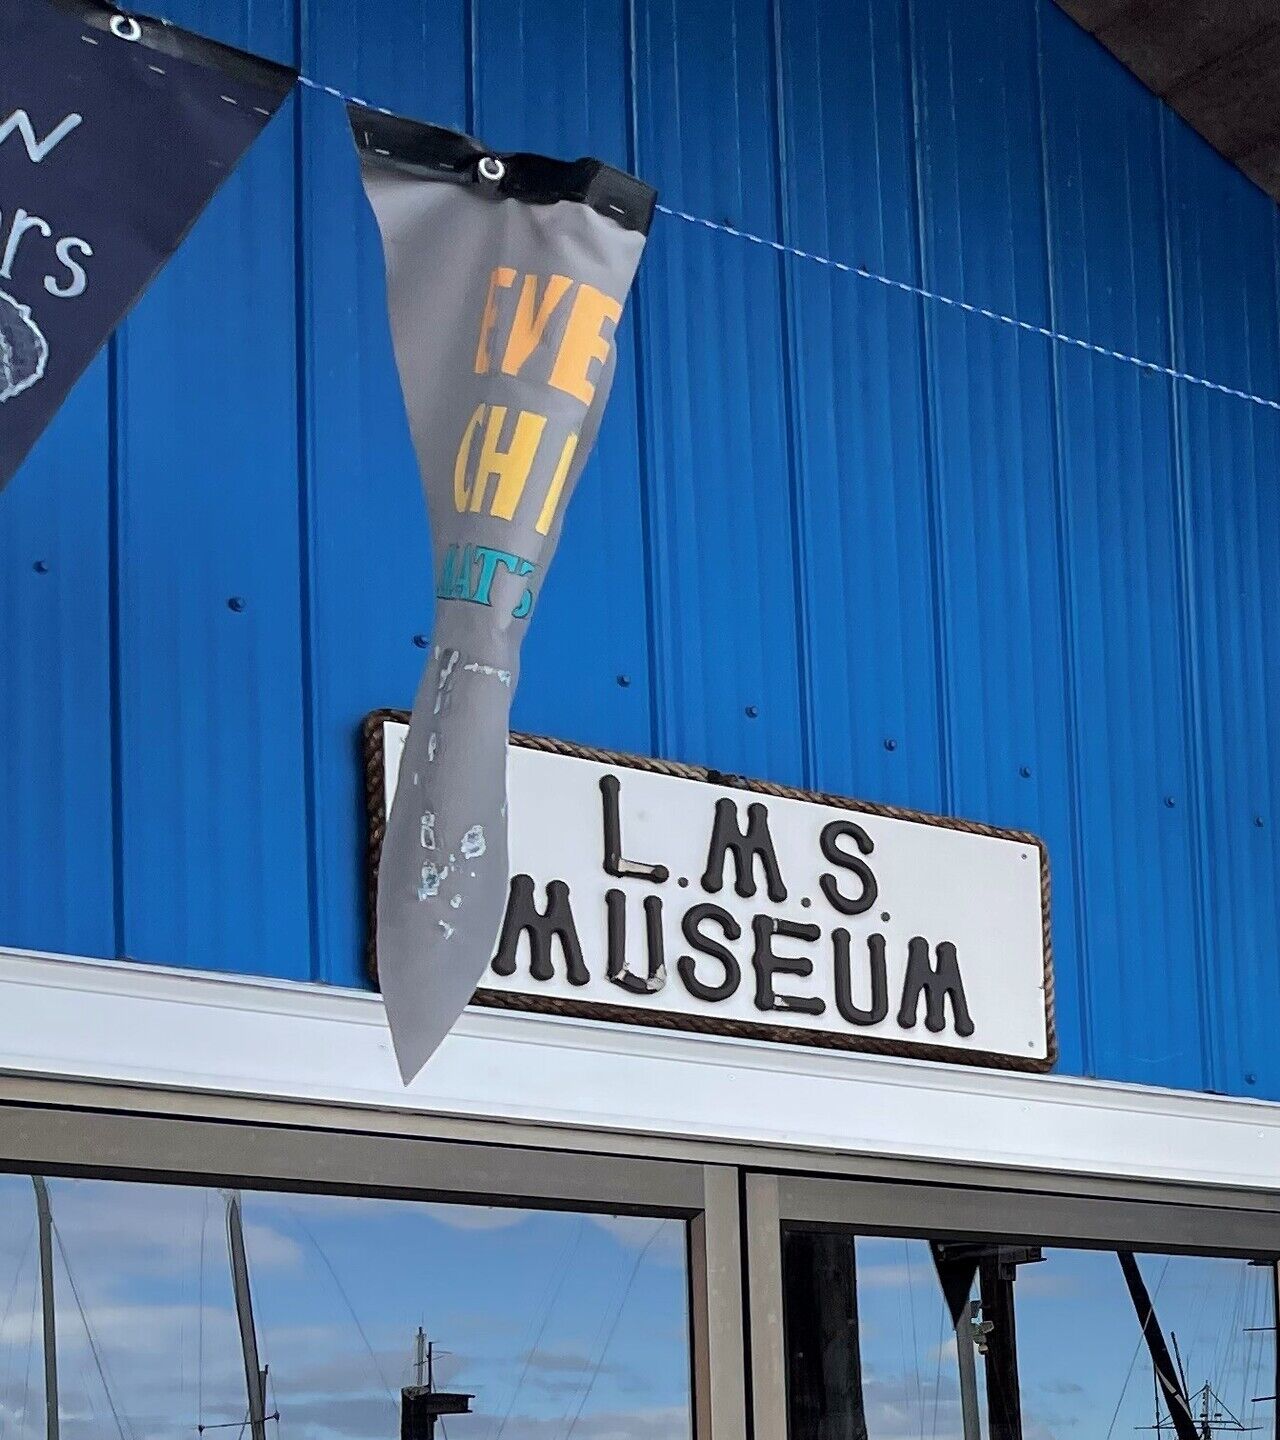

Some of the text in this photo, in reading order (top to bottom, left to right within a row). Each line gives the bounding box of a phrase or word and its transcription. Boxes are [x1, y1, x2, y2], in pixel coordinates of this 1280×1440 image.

[0, 209, 93, 297] rs
[599, 774, 890, 921] L.M.S.
[491, 874, 974, 1037] MUSEUM
